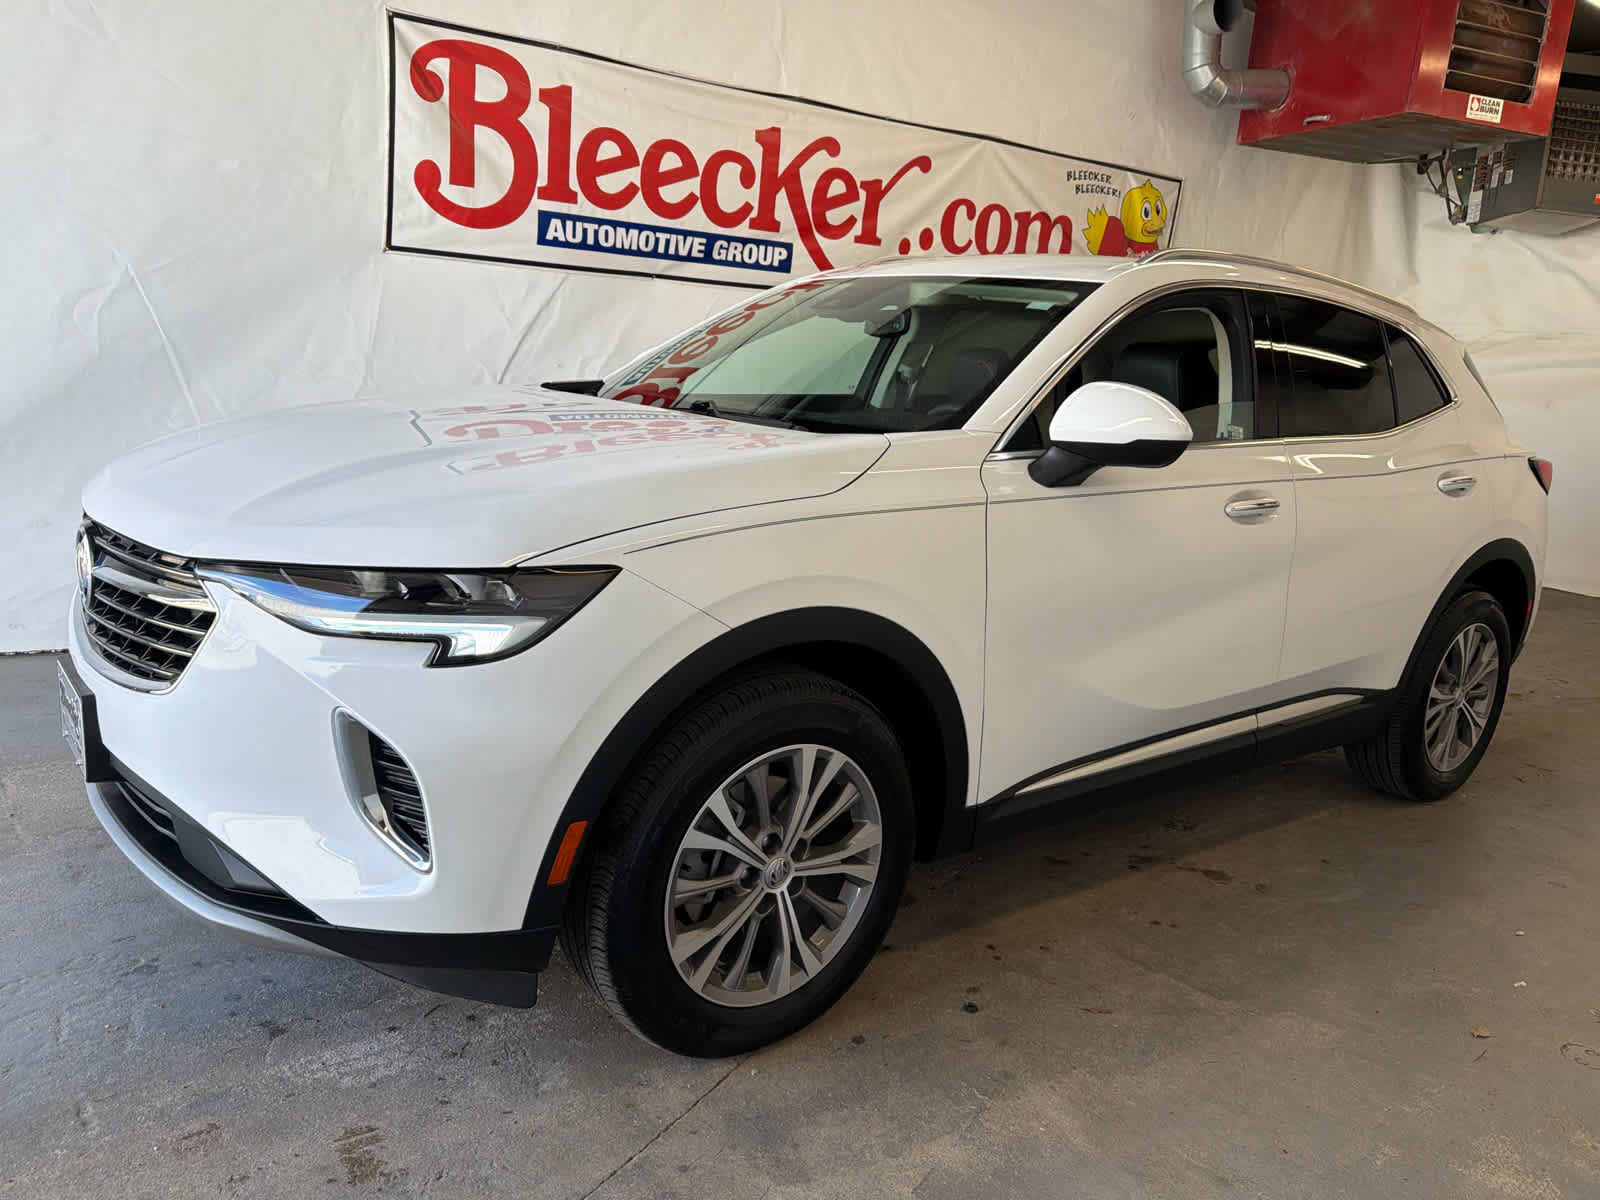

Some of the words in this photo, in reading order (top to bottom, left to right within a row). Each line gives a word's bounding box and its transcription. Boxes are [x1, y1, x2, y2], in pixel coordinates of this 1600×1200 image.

[1481, 98, 1501, 107] CLEAN
[1479, 105, 1499, 115] BURN
[1066, 170, 1112, 184] BLEECKER
[545, 218, 706, 258] AUTOMOTIVE
[712, 240, 788, 267] GROUP
